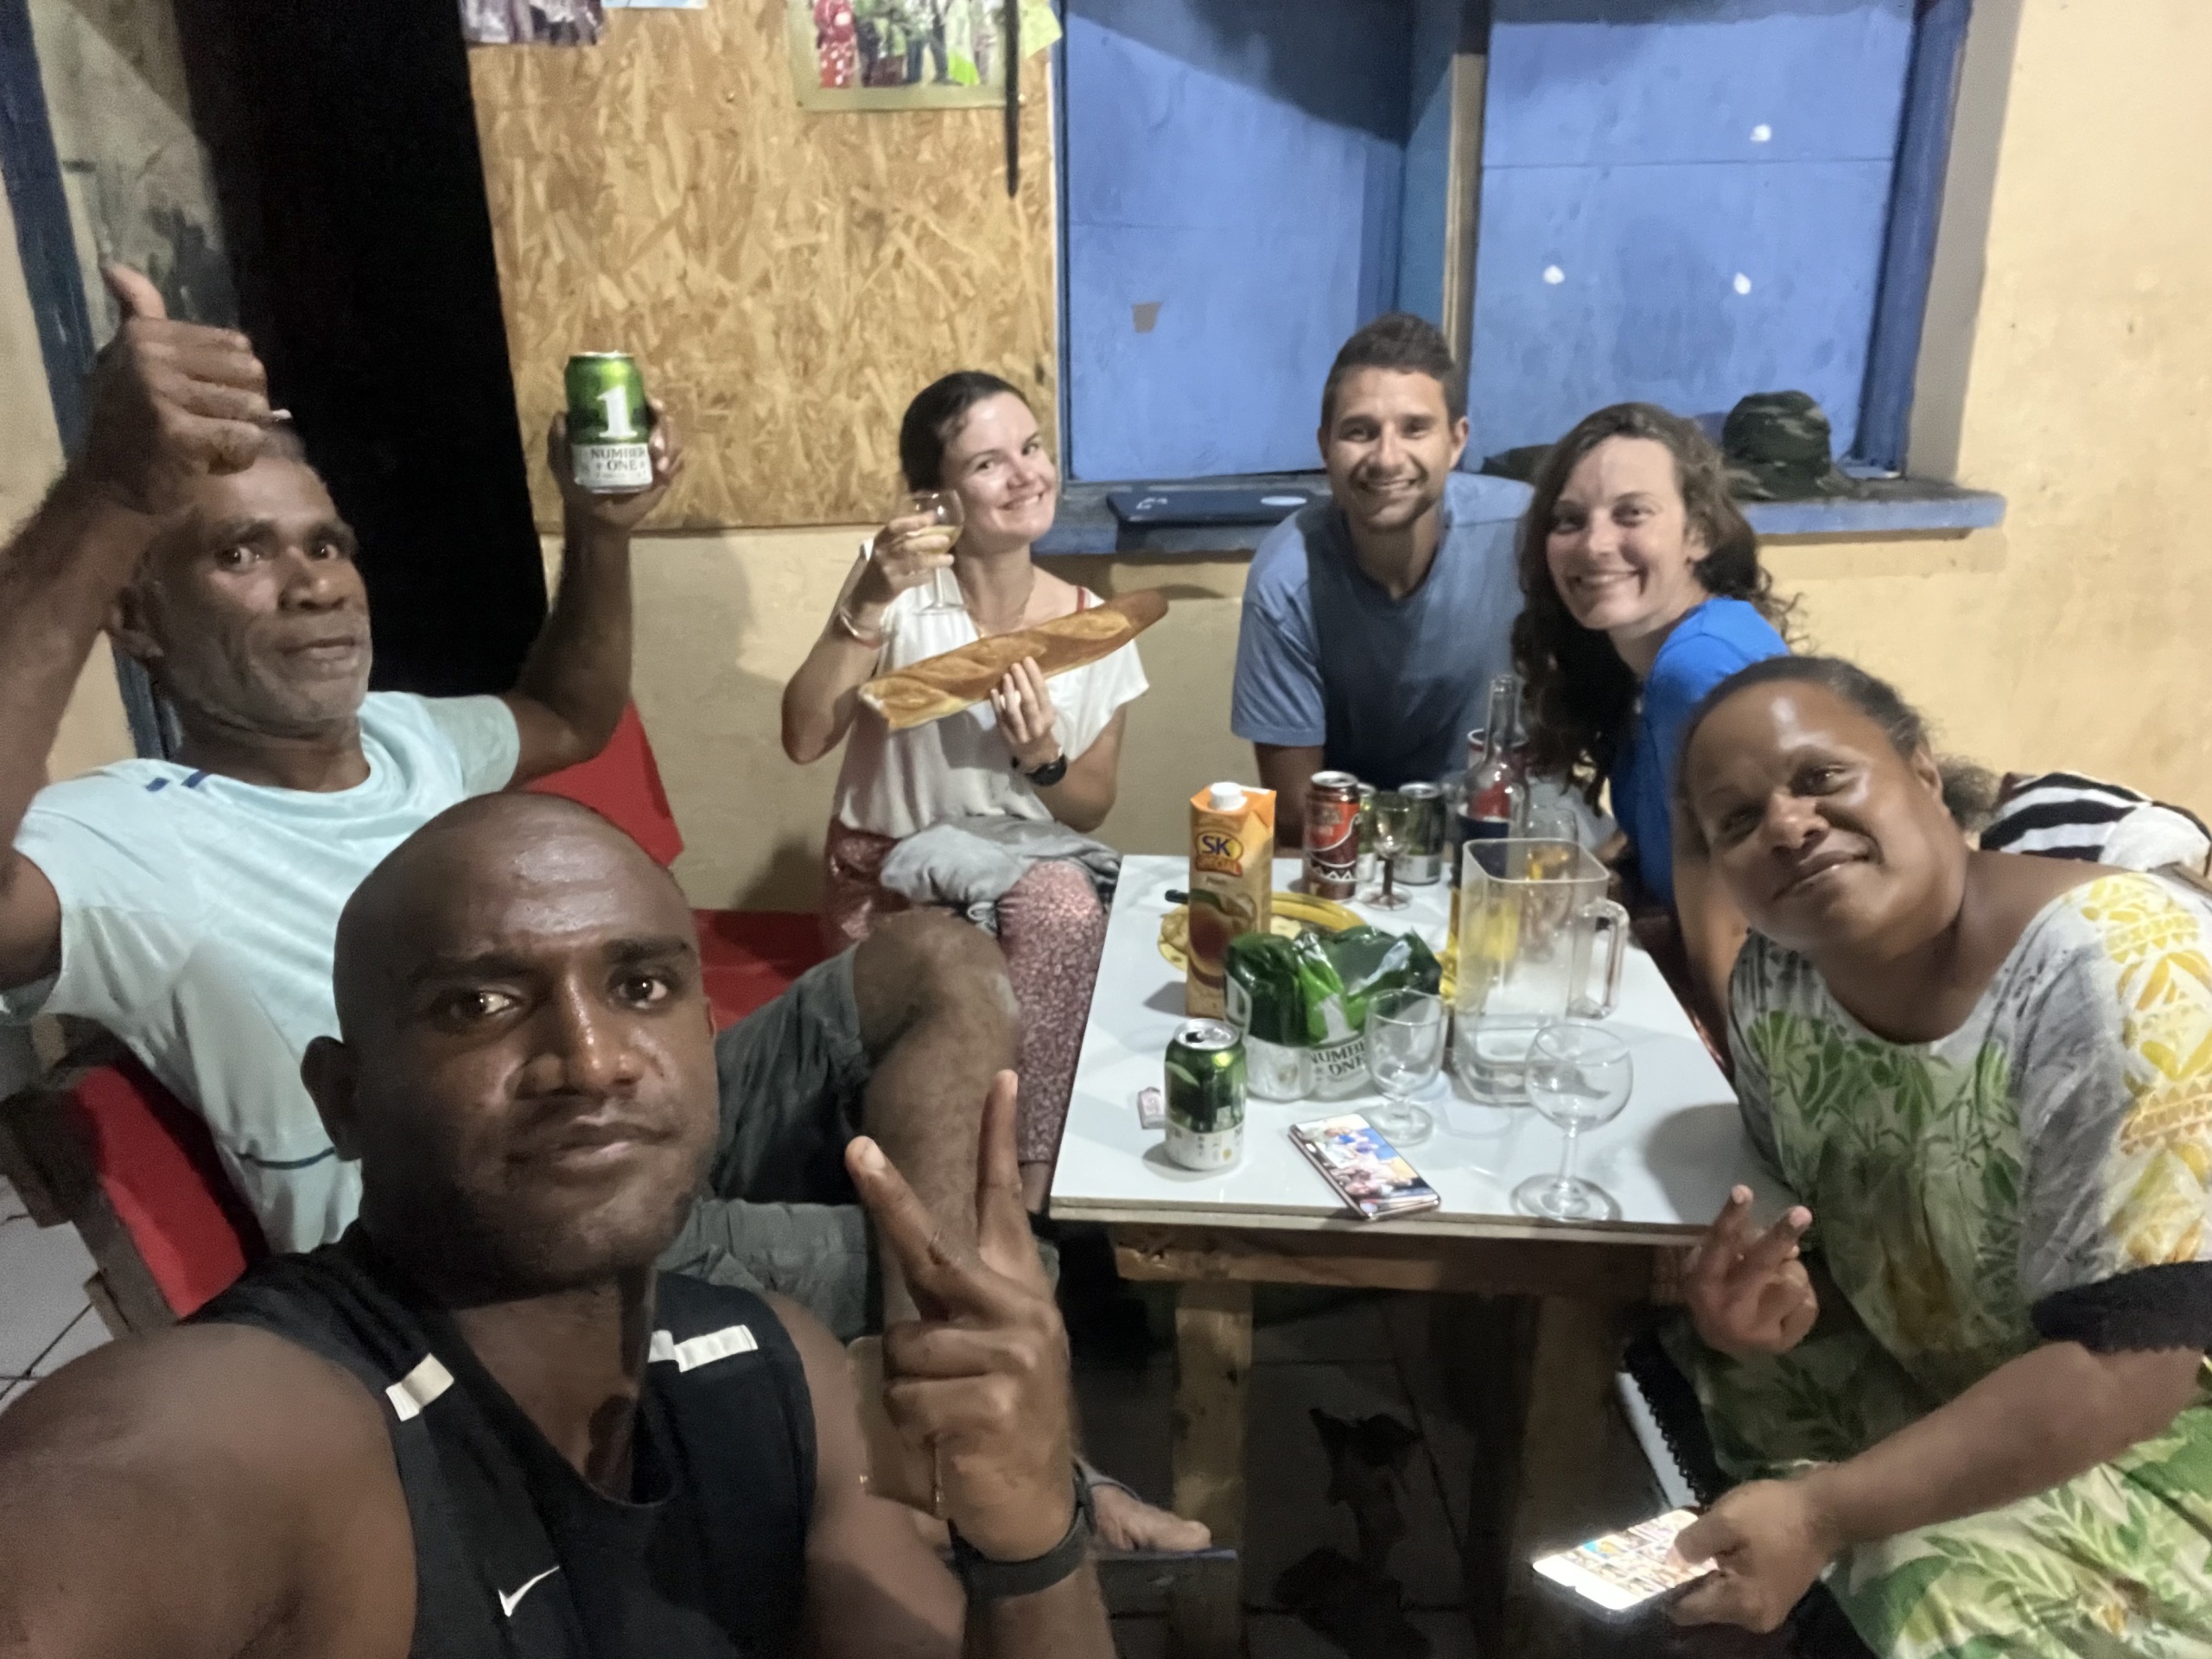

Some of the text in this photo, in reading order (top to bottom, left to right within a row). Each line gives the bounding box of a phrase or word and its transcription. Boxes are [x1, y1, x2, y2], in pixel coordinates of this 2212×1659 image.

[597, 385, 638, 438] 1
[591, 447, 645, 459] NUMBER
[607, 461, 638, 471] ONE
[1202, 836, 1230, 856] SK
